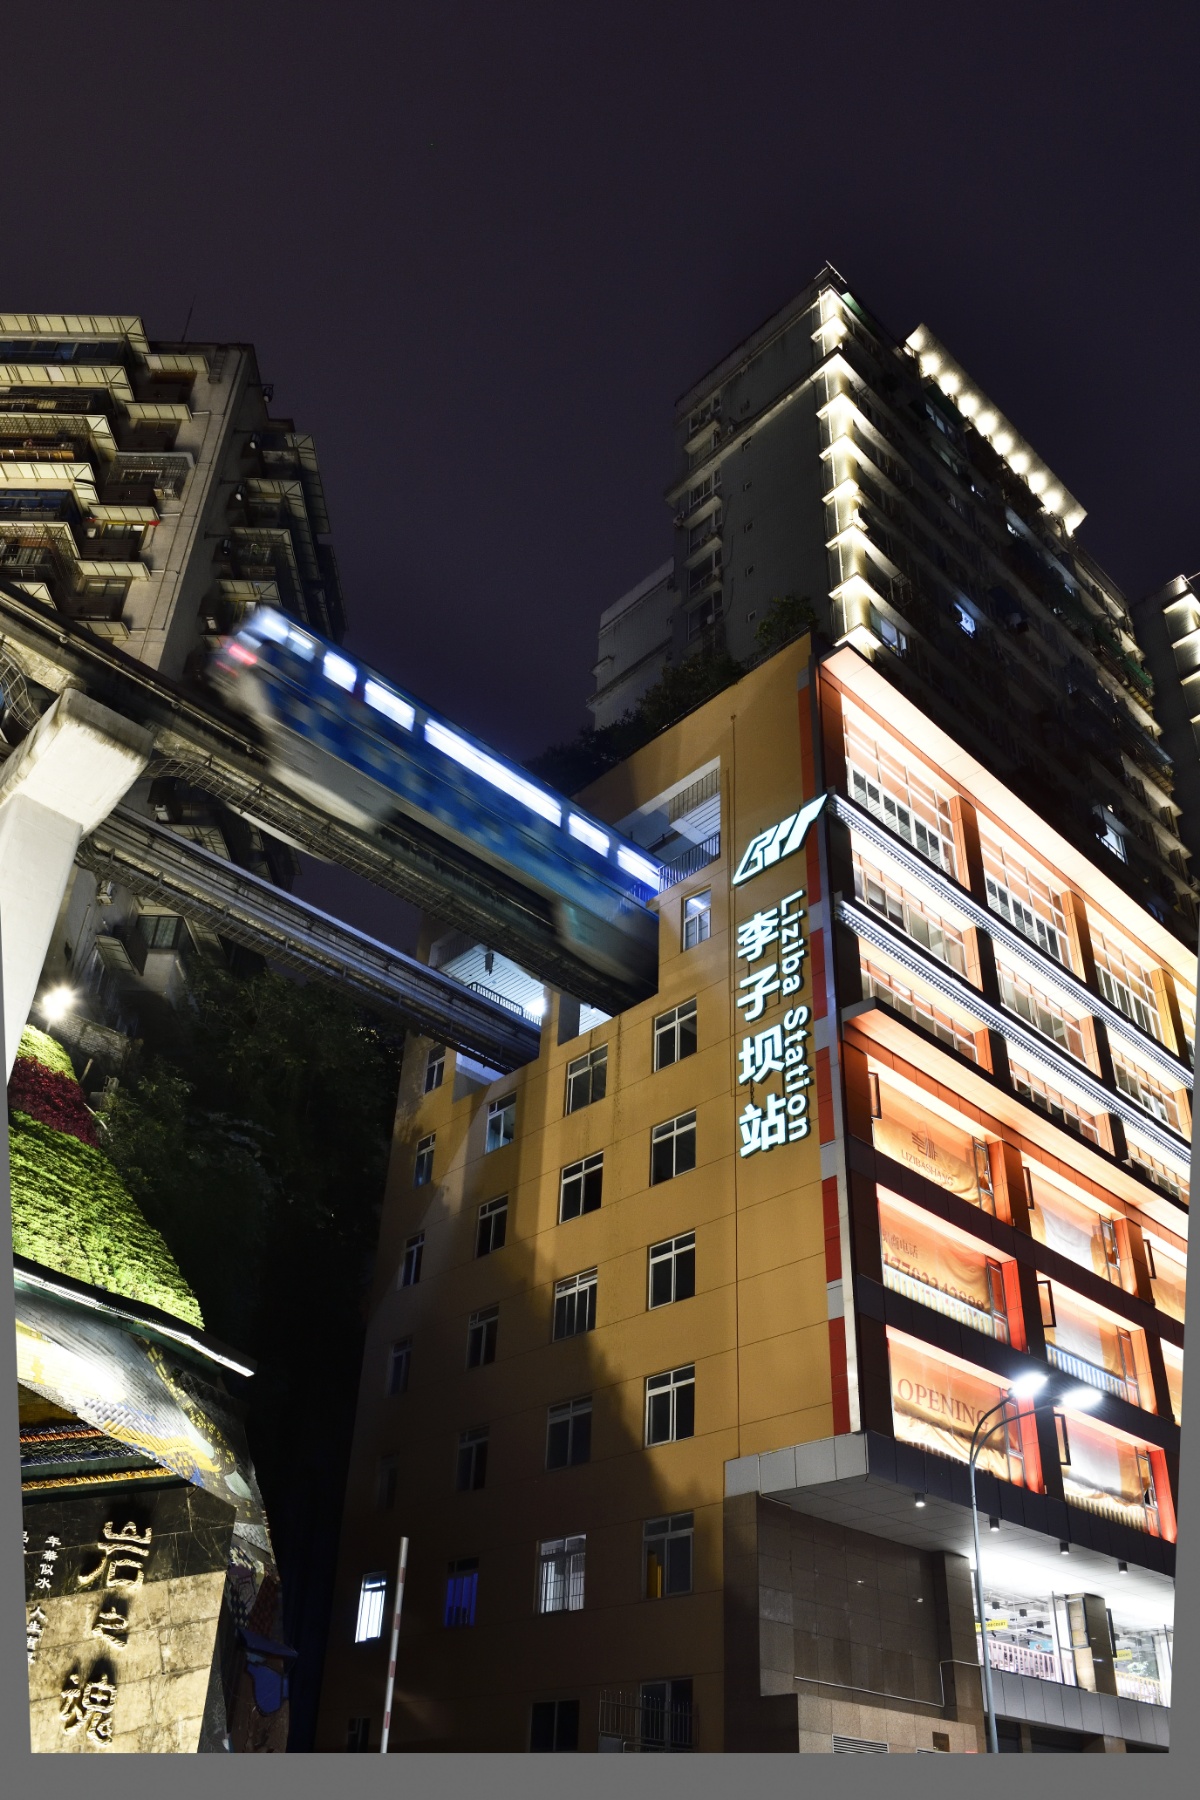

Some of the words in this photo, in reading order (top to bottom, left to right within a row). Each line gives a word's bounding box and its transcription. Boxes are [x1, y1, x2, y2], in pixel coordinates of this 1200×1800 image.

[781, 890, 804, 992] Liziba
[737, 909, 786, 1158] 李子坝站
[783, 1006, 809, 1141] Station
[897, 1378, 989, 1431] OPENING
